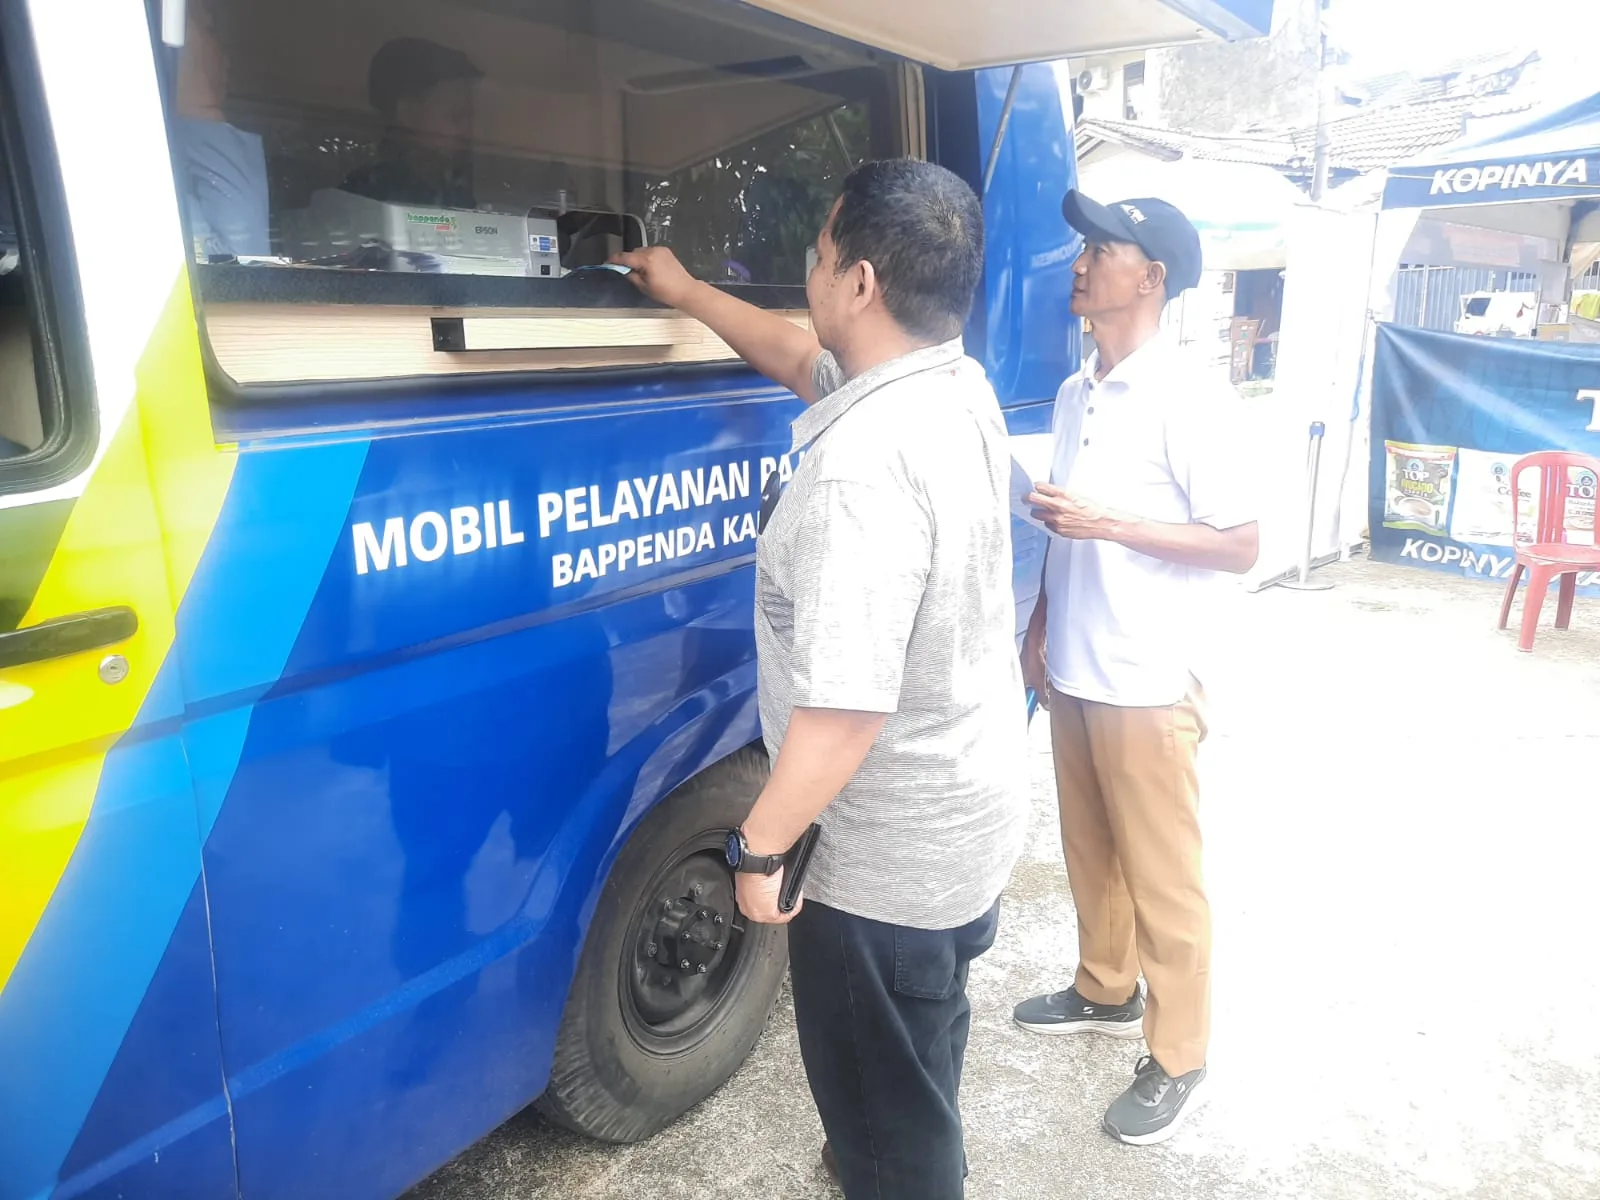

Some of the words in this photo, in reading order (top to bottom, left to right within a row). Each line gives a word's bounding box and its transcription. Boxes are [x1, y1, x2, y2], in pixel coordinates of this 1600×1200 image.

[1430, 158, 1587, 195] KOPINYA
[475, 226, 498, 235] EPSON
[1402, 468, 1430, 481] TOP
[1565, 483, 1597, 498] TO
[351, 498, 524, 576] MOBIL
[537, 464, 750, 538] PELAYANAN
[760, 451, 806, 493] PA
[552, 527, 715, 588] BAPPENDA
[723, 511, 760, 546] KA
